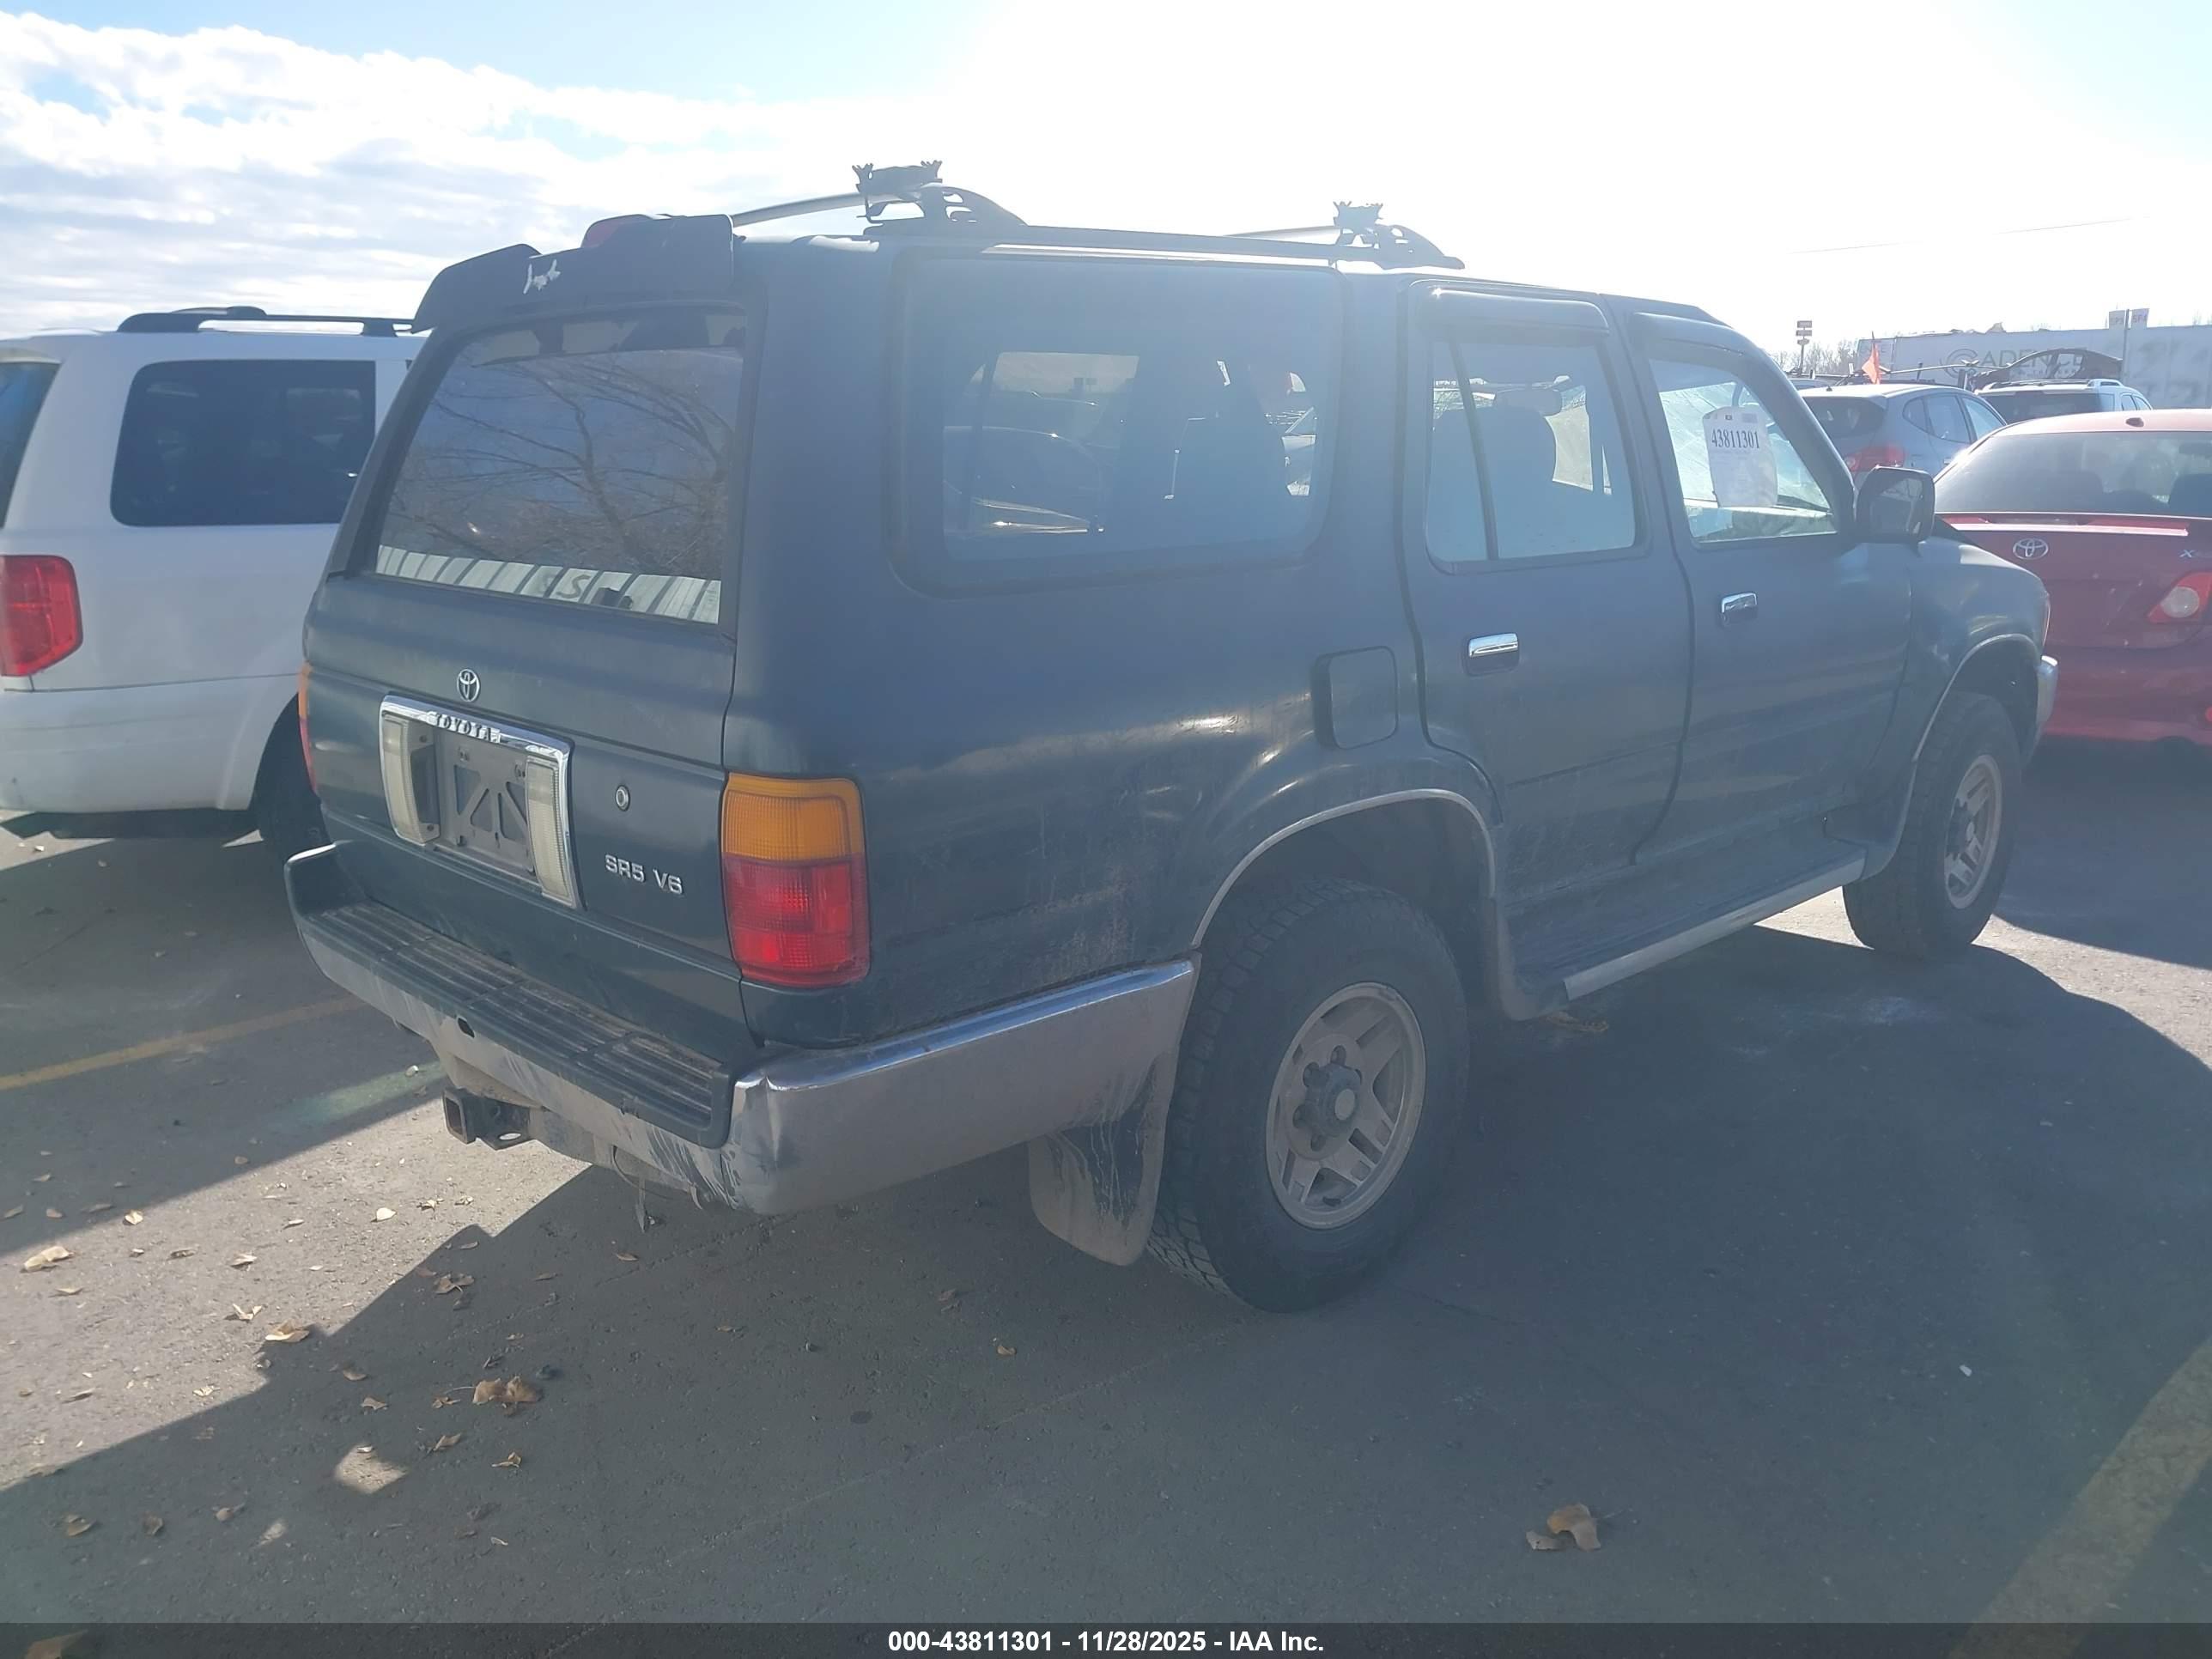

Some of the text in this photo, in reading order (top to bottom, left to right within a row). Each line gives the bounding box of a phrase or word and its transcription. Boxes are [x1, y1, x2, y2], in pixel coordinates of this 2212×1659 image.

[1711, 428, 1759, 449] 43811301
[434, 712, 492, 741] TOYOTA
[605, 854, 684, 895] SR5 V6
